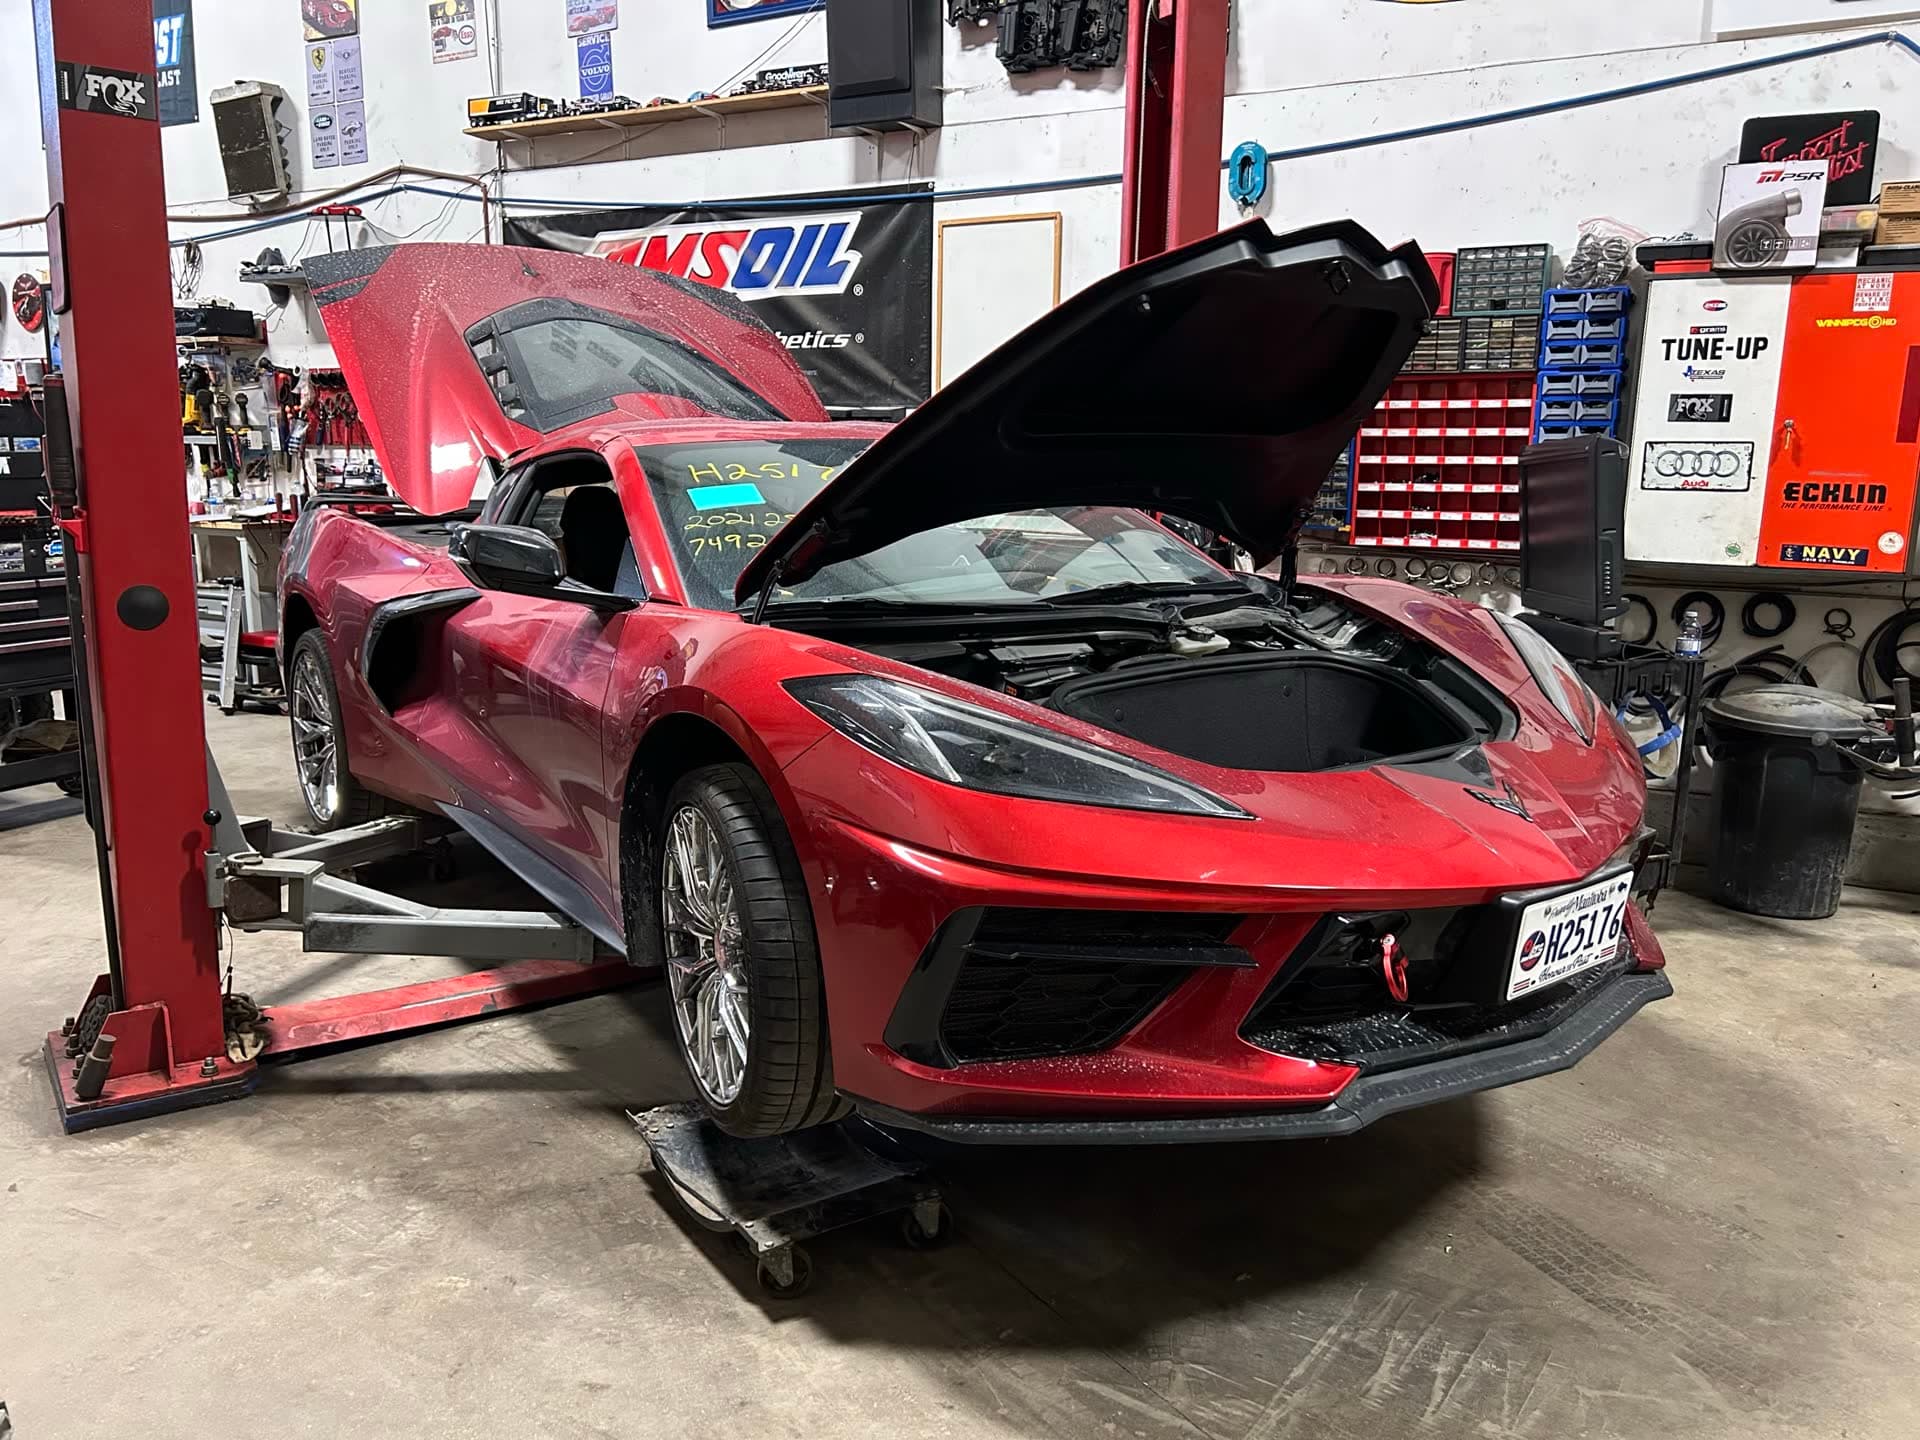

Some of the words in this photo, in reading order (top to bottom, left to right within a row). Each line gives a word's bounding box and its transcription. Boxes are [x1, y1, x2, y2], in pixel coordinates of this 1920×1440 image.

[581, 64, 610, 77] VOLVO
[85, 74, 146, 110] FOX
[1661, 336, 1769, 361] TUNE-UP
[1676, 398, 1714, 415] FOX
[1681, 479, 1709, 487] Audi
[1800, 503, 1862, 511] PERFORMANCE
[684, 512, 755, 530] 2021
[1802, 546, 1861, 561] NAVY
[1544, 900, 1625, 965] H25176
